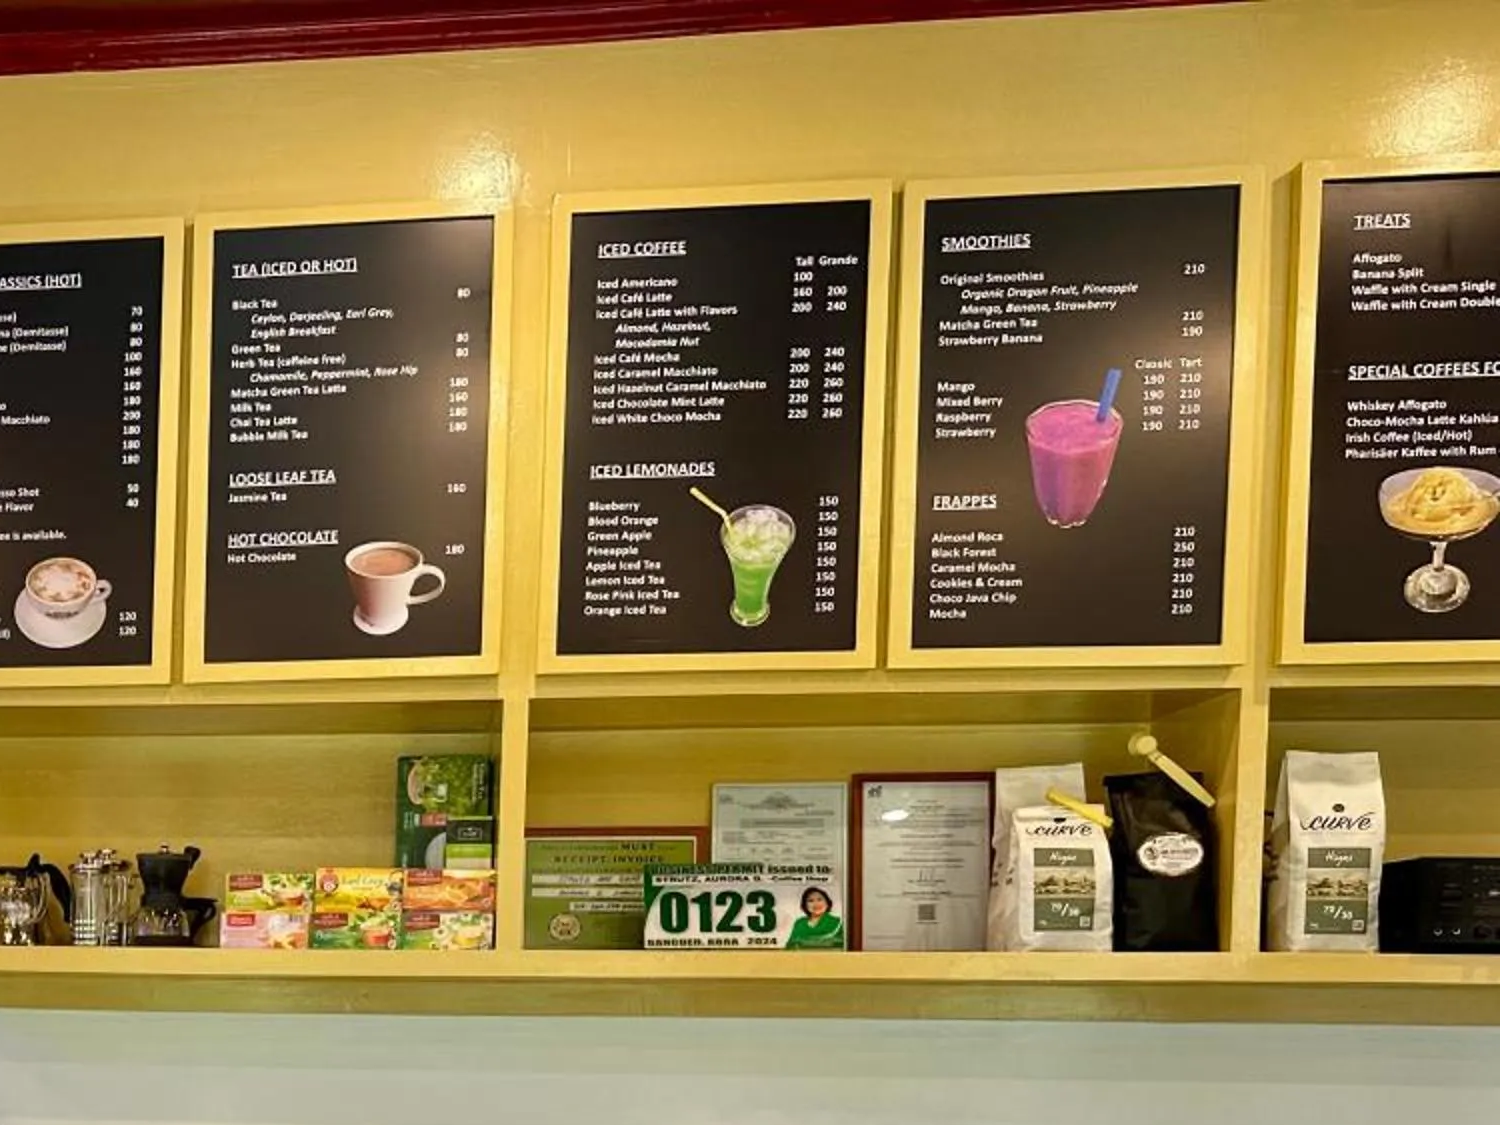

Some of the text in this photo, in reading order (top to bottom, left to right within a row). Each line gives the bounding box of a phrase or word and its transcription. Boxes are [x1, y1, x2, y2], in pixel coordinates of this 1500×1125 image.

[1354, 213, 1411, 230] TREATS
[598, 241, 686, 258] ICED COFFEE
[942, 234, 1031, 251] SMOOTHIES
[796, 254, 858, 266] Tall Grande
[1353, 253, 1401, 264] Affogato
[232, 258, 357, 278] TEA (ICED OR HOT)
[940, 263, 1205, 285] Original Smoothies 210
[1352, 267, 1423, 279] Banana Split
[45, 273, 82, 288] (HOT)
[598, 272, 813, 289] Iced Americano 100
[1352, 280, 1496, 295] Waffle with Cream Single
[131, 307, 143, 317] 70
[232, 301, 259, 310] Black
[261, 300, 278, 309] Tea
[596, 301, 846, 319] Iced Café Latte with Flavors 200 240
[1352, 300, 1388, 311] Waffle
[1391, 299, 1416, 310] with
[1420, 299, 1457, 309] Cream
[250, 326, 337, 340] English Breakfast
[939, 326, 1202, 347] Strawberry Banana 190
[124, 352, 142, 361] 100
[232, 344, 281, 354] Green Tea
[1348, 365, 1409, 380] SPECIAL
[1413, 362, 1479, 378] COFFEES
[1347, 400, 1447, 412] Whiskey Affogato
[1346, 416, 1424, 427] Choco-Mocha
[1427, 415, 1456, 425] Latte
[1346, 430, 1472, 443] Irish Coffee (Iced/Hot)
[1440, 446, 1466, 456] with
[1469, 445, 1496, 455] Rum
[228, 469, 336, 487] LOOSE LEAF TEA
[590, 462, 715, 479] ICED LEMONADES
[18, 487, 39, 497] Shot
[933, 495, 997, 510] FRAPPES
[228, 530, 339, 548] HOT CHOCOLATE
[588, 527, 837, 541] Green Apple 150
[932, 527, 1195, 543] Almond Roca 210
[228, 552, 296, 563] Hot Chocolate
[932, 558, 1194, 573] Caramel Mocha 210
[931, 573, 1193, 589] Cookies & Cream 210
[584, 602, 834, 616] Orange Iced Tea 150
[659, 890, 777, 933] 0123
